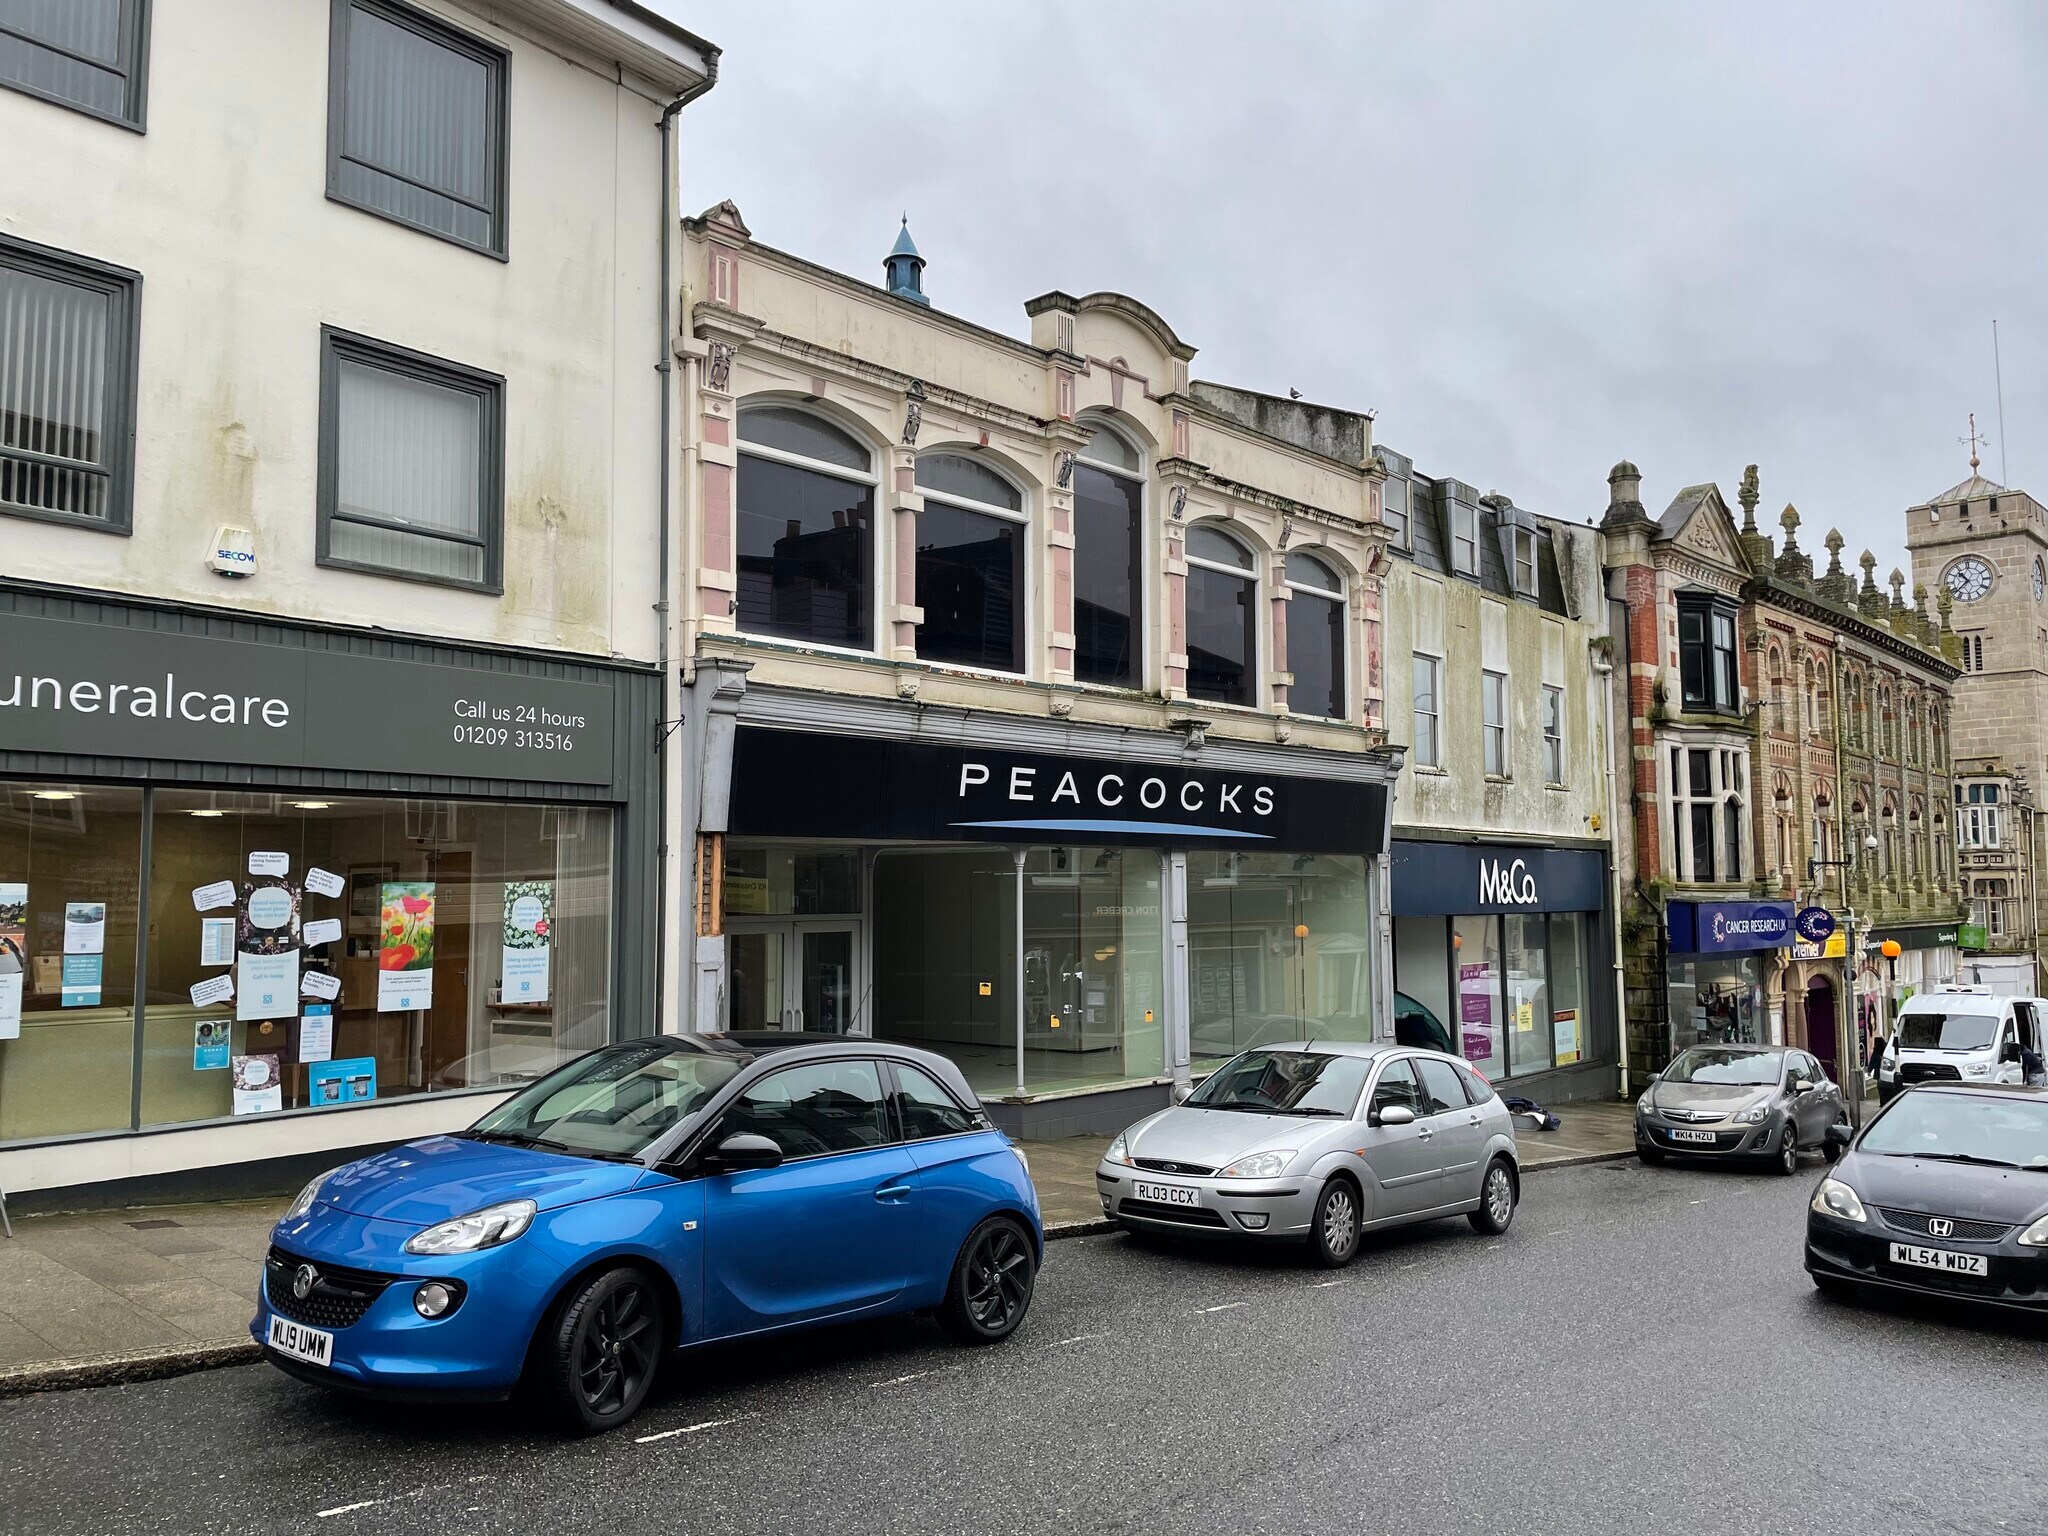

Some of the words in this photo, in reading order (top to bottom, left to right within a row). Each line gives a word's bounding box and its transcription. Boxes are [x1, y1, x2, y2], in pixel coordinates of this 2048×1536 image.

[218, 550, 254, 562] SECOM
[0, 672, 290, 728] uneralcare
[454, 700, 486, 718] Call
[492, 708, 510, 720] us
[516, 706, 536, 724] 24
[542, 706, 585, 728] hours
[454, 724, 508, 746] 01209
[514, 730, 573, 750] 313516
[959, 763, 1275, 816] PEACOCKS
[1480, 858, 1538, 904] M&Co.
[1726, 920, 1749, 934] CANCER
[1750, 919, 1778, 932] RESEARCH
[1778, 919, 1786, 931] UK
[1793, 942, 1819, 958] Premier
[1866, 940, 1884, 950] Superdr
[1675, 1131, 1693, 1139] WK14
[1695, 1132, 1712, 1140] HZU
[1139, 1185, 1167, 1200] RL03
[1171, 1189, 1194, 1204] CCX
[1898, 1246, 1940, 1266] WL54
[1946, 1254, 1979, 1272] WDZ
[272, 1319, 297, 1349] WL19
[299, 1329, 326, 1359] UMW
